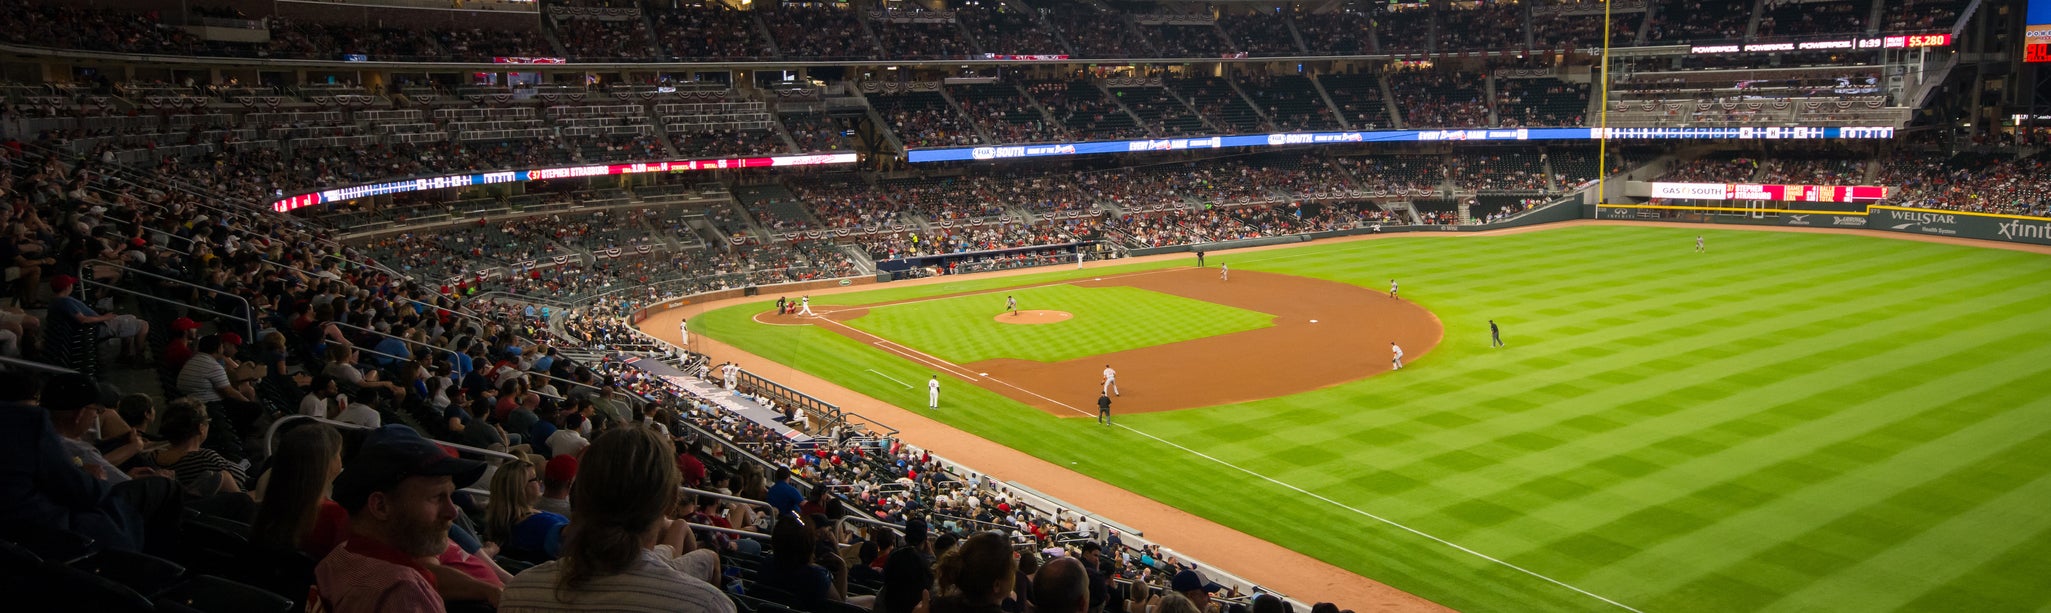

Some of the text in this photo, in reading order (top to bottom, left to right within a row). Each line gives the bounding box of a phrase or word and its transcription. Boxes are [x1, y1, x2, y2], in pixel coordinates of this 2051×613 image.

[1909, 35, 1944, 47] $5,280
[1587, 46, 1600, 56] 42
[1670, 128, 1678, 138] 5
[1684, 128, 1692, 138] 6
[1699, 128, 1707, 138] 7
[1714, 128, 1721, 138] 8
[1729, 128, 1737, 138] 9
[1286, 134, 1313, 143] SOUTH
[996, 147, 1025, 157] SOUTH
[532, 165, 609, 179] 37 STEPHEN STRASBURG
[1688, 187, 1722, 195] SOUTH
[1735, 184, 1763, 192] STEPHEN
[1891, 210, 1955, 225] WELLSTAR
[1938, 227, 1956, 235] System
[1998, 219, 2051, 240] xfinit
